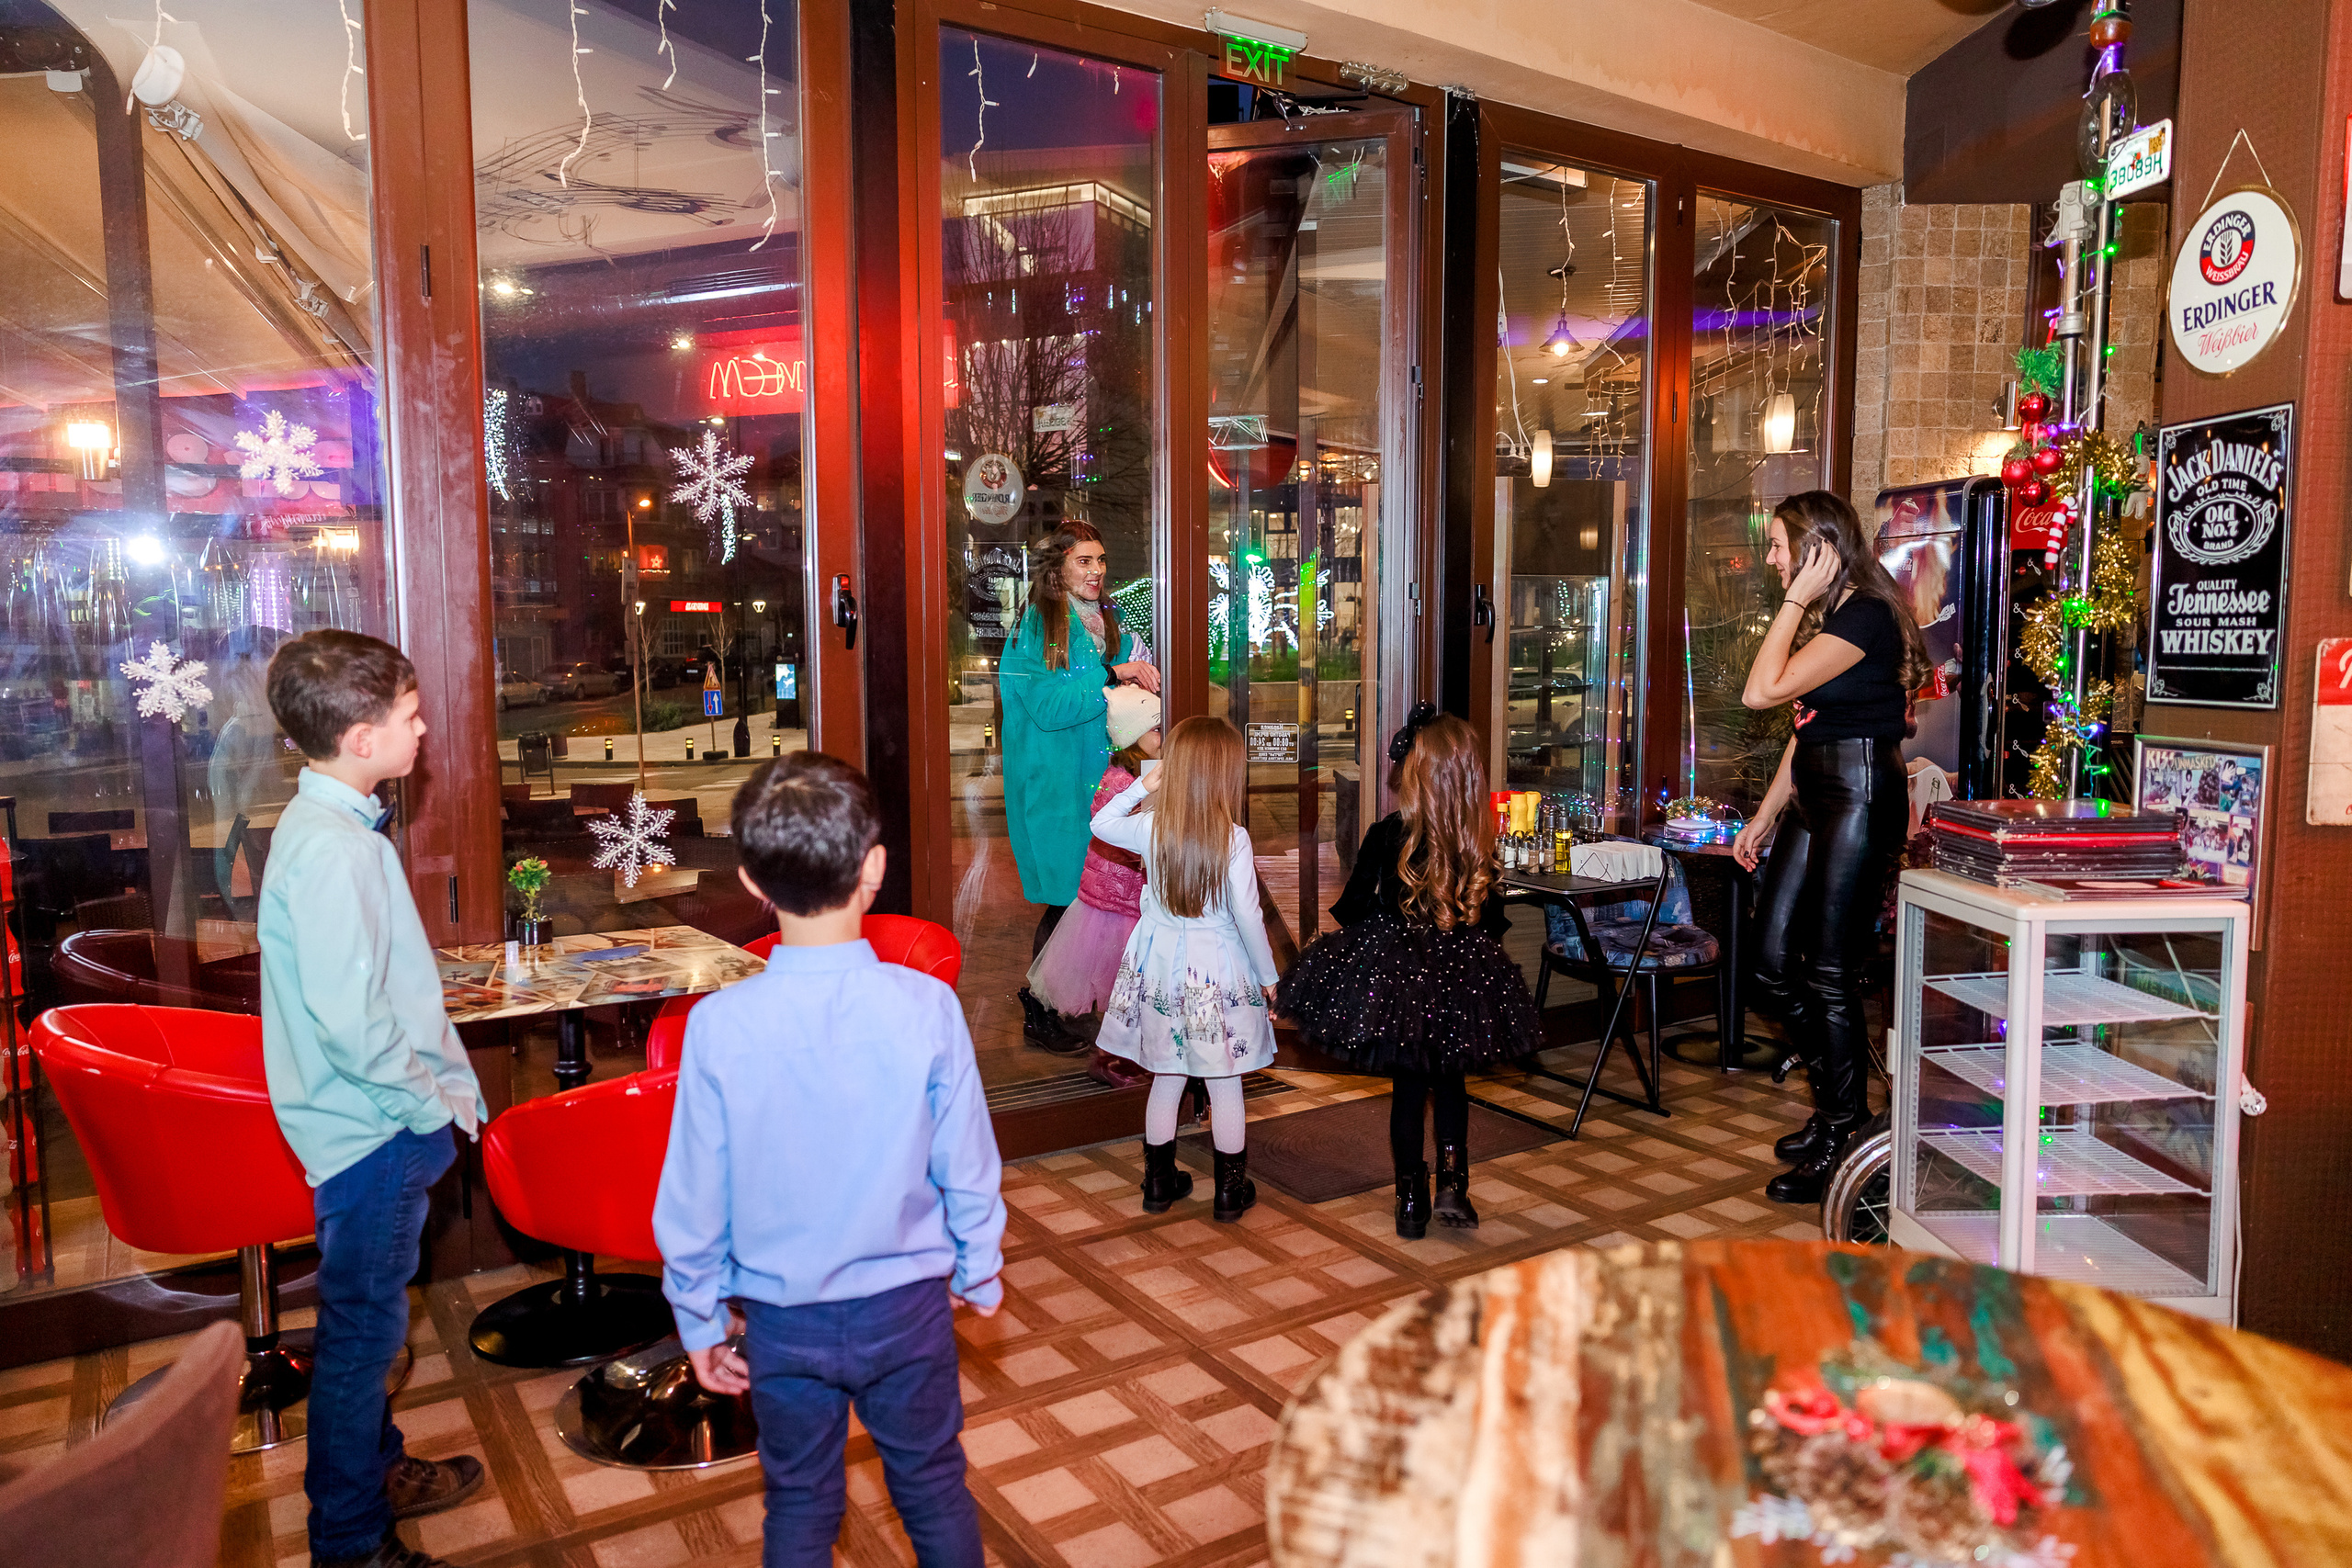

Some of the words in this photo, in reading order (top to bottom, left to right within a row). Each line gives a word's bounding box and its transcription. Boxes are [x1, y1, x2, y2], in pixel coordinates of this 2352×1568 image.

[1227, 42, 1289, 85] EXIT
[2202, 214, 2251, 252] ERDINGER
[2183, 281, 2278, 333] ERDINGER
[2198, 322, 2258, 358] Weißbier
[2166, 449, 2212, 502] JACK
[2197, 481, 2219, 497] OLD
[2222, 479, 2248, 491] TIME
[2205, 504, 2236, 523] Old
[2203, 539, 2234, 551] BRAND
[2197, 579, 2237, 592] QUALITY
[2167, 583, 2271, 615] Tennessee
[2176, 618, 2211, 627] SOUR
[2218, 616, 2256, 626] MASH
[2160, 629, 2276, 655] WHISKEY
[2146, 750, 2175, 770] KISS
